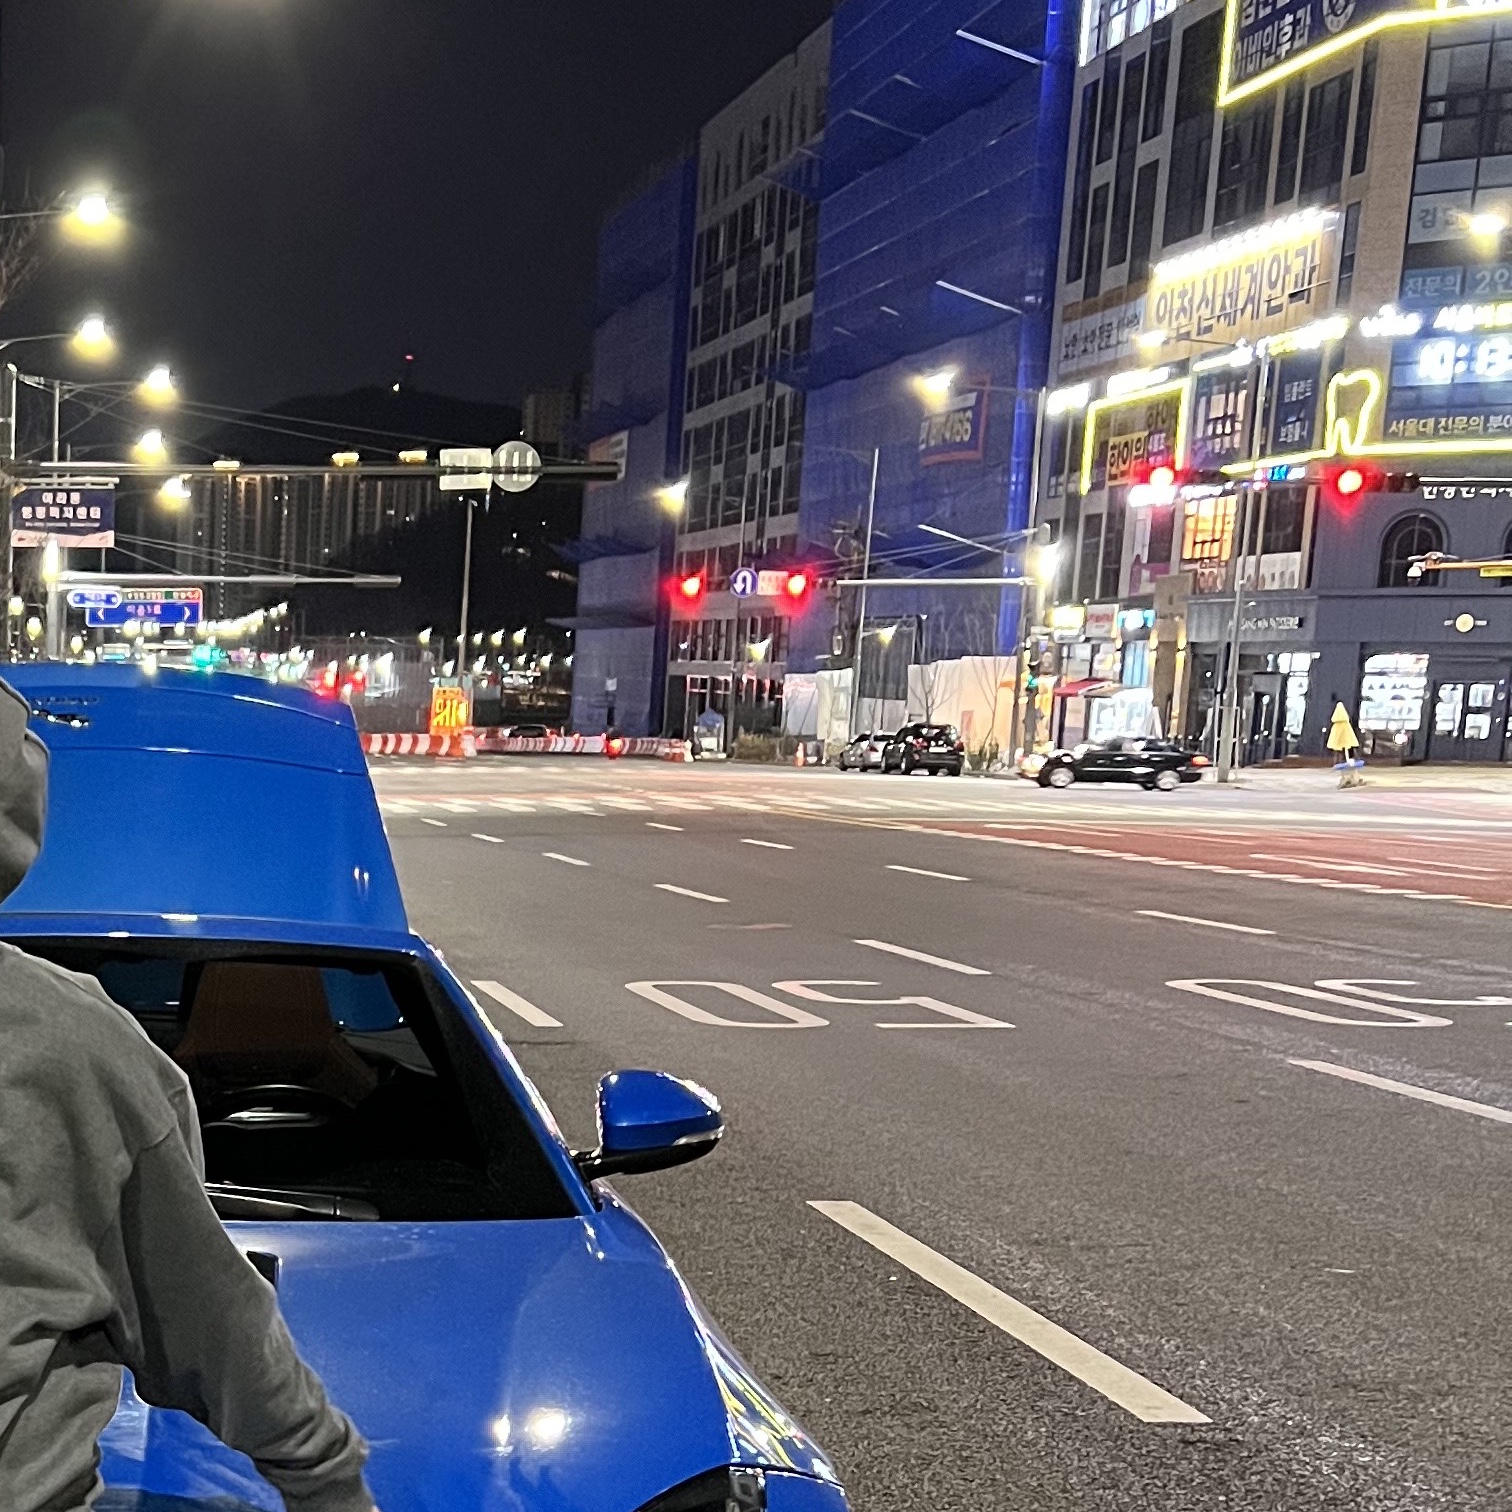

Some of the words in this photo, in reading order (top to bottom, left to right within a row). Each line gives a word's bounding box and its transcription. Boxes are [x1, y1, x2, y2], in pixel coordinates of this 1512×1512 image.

[1235, 4, 1311, 79] 이비인후과
[1404, 273, 1462, 298] 전문의
[1389, 416, 1435, 438] 서울대
[1438, 414, 1484, 436] 전문의
